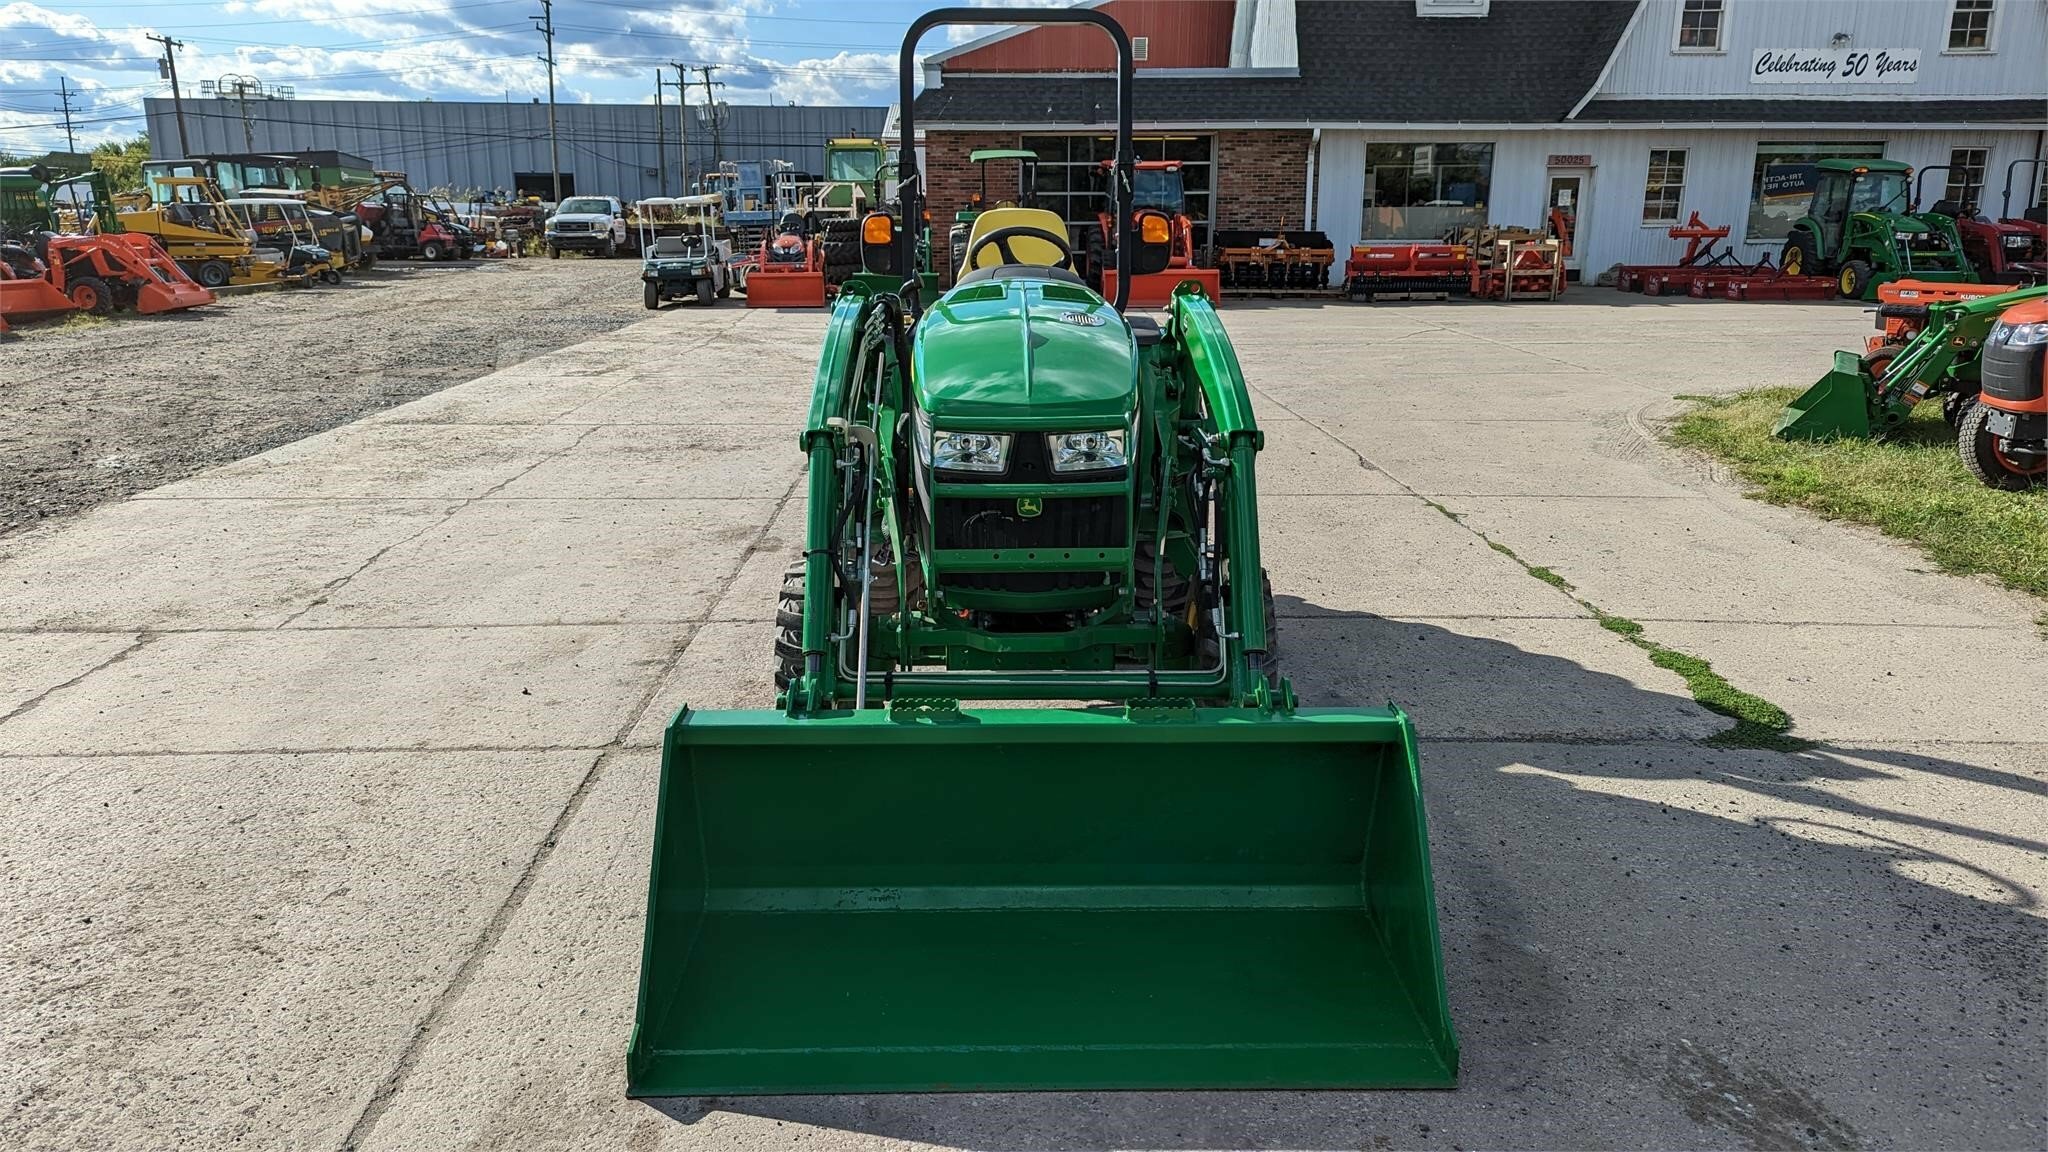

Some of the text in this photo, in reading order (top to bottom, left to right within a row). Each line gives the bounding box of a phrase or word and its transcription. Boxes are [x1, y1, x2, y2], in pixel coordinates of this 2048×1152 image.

[1755, 51, 1918, 79] Celebrating 50 Years
[1554, 155, 1584, 165] 50025
